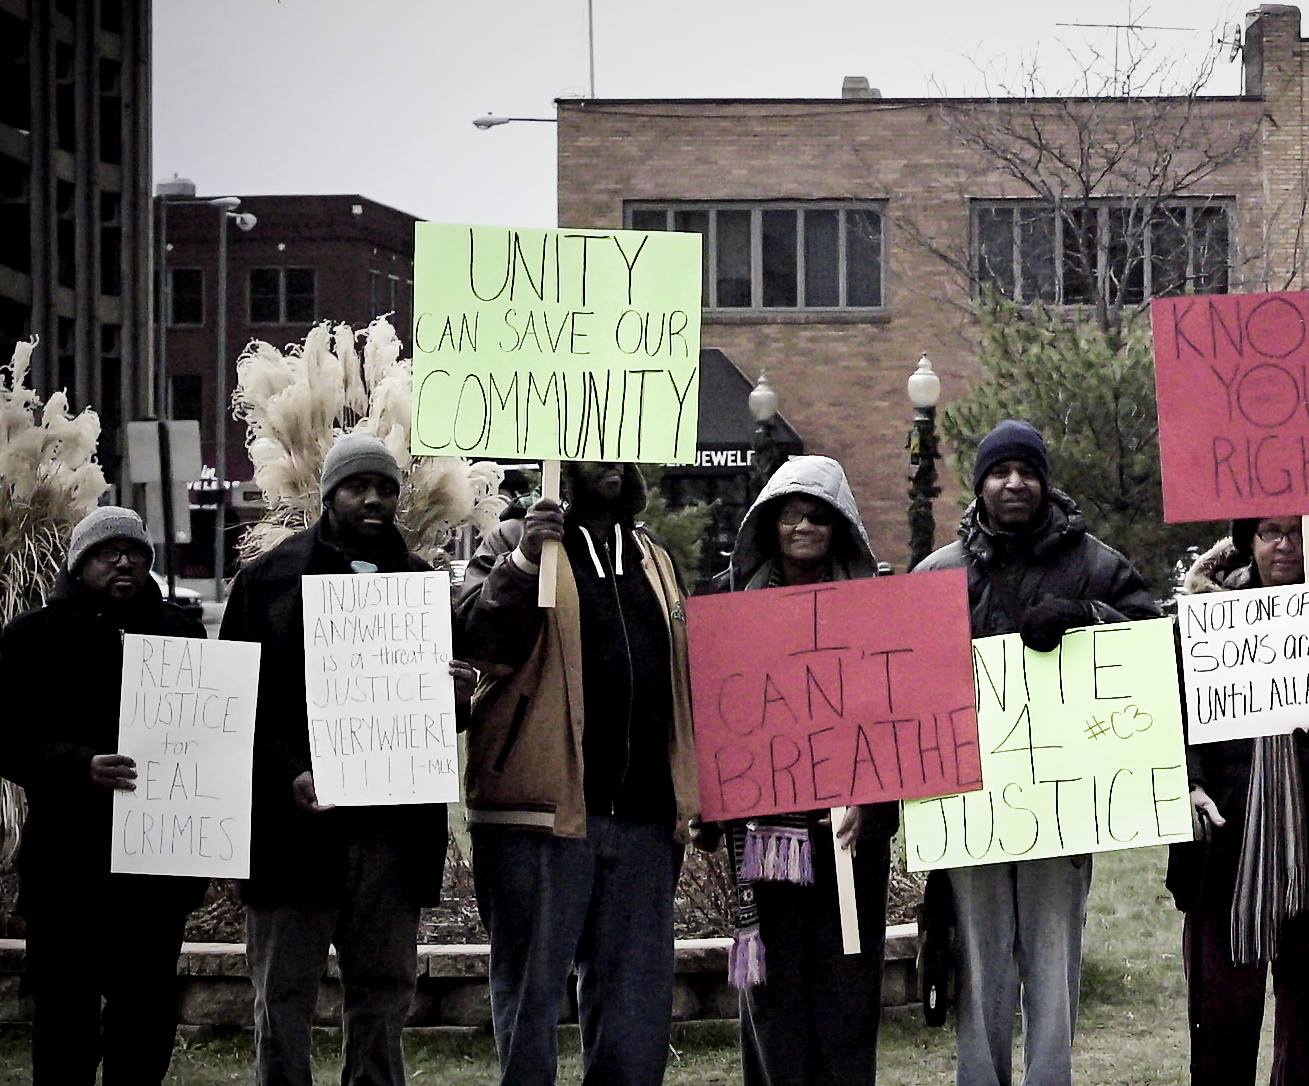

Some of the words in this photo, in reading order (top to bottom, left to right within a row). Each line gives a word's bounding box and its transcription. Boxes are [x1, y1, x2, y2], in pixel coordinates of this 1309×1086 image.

[469, 227, 649, 307] UNITY
[415, 311, 480, 354] CAN
[498, 308, 595, 355] SAVE
[615, 309, 689, 358] OUR
[416, 367, 697, 460] COMMUNITY
[321, 576, 436, 615] INJUSTICE
[1187, 598, 1240, 639] NOT
[1245, 595, 1281, 626] ONE
[313, 611, 433, 647] ANYWHERE
[783, 587, 851, 656] I
[140, 638, 221, 691] REAL
[323, 655, 338, 673] is
[350, 652, 364, 670] a
[371, 643, 425, 665] threat
[432, 642, 448, 664] to
[973, 627, 1132, 712] NITE
[1190, 634, 1277, 673] SONS
[123, 691, 239, 733] JUSTICE
[312, 673, 437, 709] JUSTICE
[717, 648, 914, 737] CAN'T
[1269, 675, 1302, 711] ALL
[311, 712, 456, 758] EVERYWHERE
[713, 704, 984, 813] BREATHE
[990, 703, 1064, 785] 4
[121, 760, 221, 800] EAL
[123, 809, 235, 861] CRIMES
[916, 764, 1190, 863] JUSTICE
